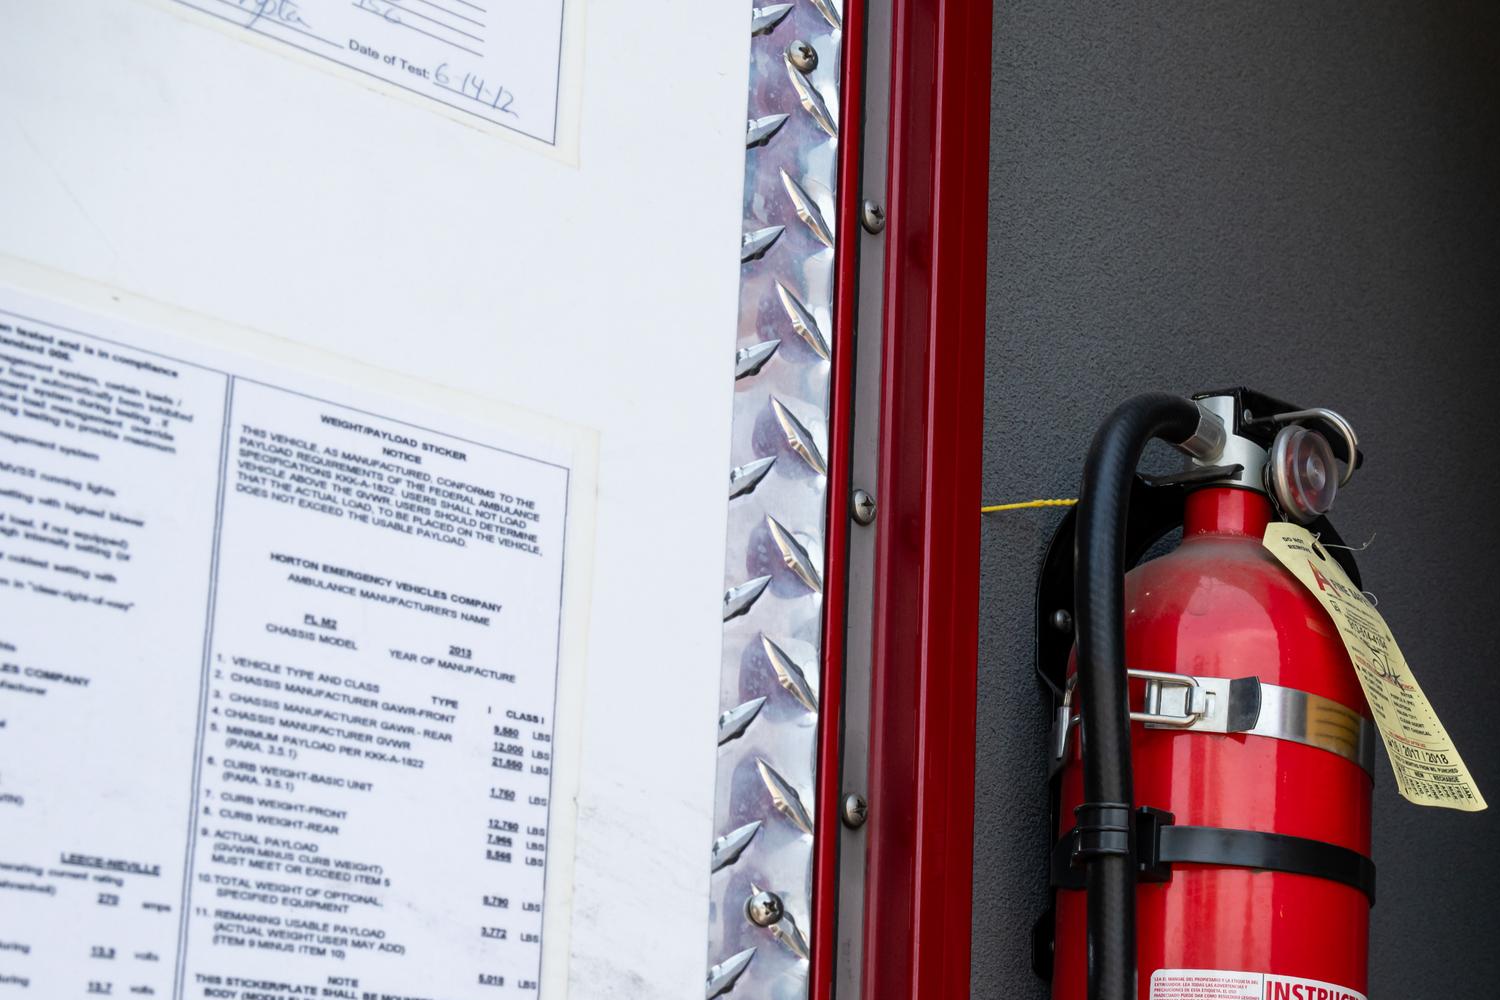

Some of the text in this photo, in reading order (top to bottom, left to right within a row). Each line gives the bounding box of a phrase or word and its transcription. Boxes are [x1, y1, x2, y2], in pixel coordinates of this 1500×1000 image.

[350, 38, 430, 80] Date of Test:
[320, 414, 466, 462] WEIGHT/PAYLOAD STICKER
[382, 448, 422, 465] NOTICE
[270, 552, 502, 613] HORTON EMERGENCY VEHICLES COMPANY
[232, 656, 380, 693] VEHICLE TYPE AND CLASS
[389, 649, 516, 683] YEAR OF MANUFACTURE
[1426, 753, 1448, 764] 2018
[204, 986, 237, 1000] BODY
[327, 976, 359, 988] NOTE
